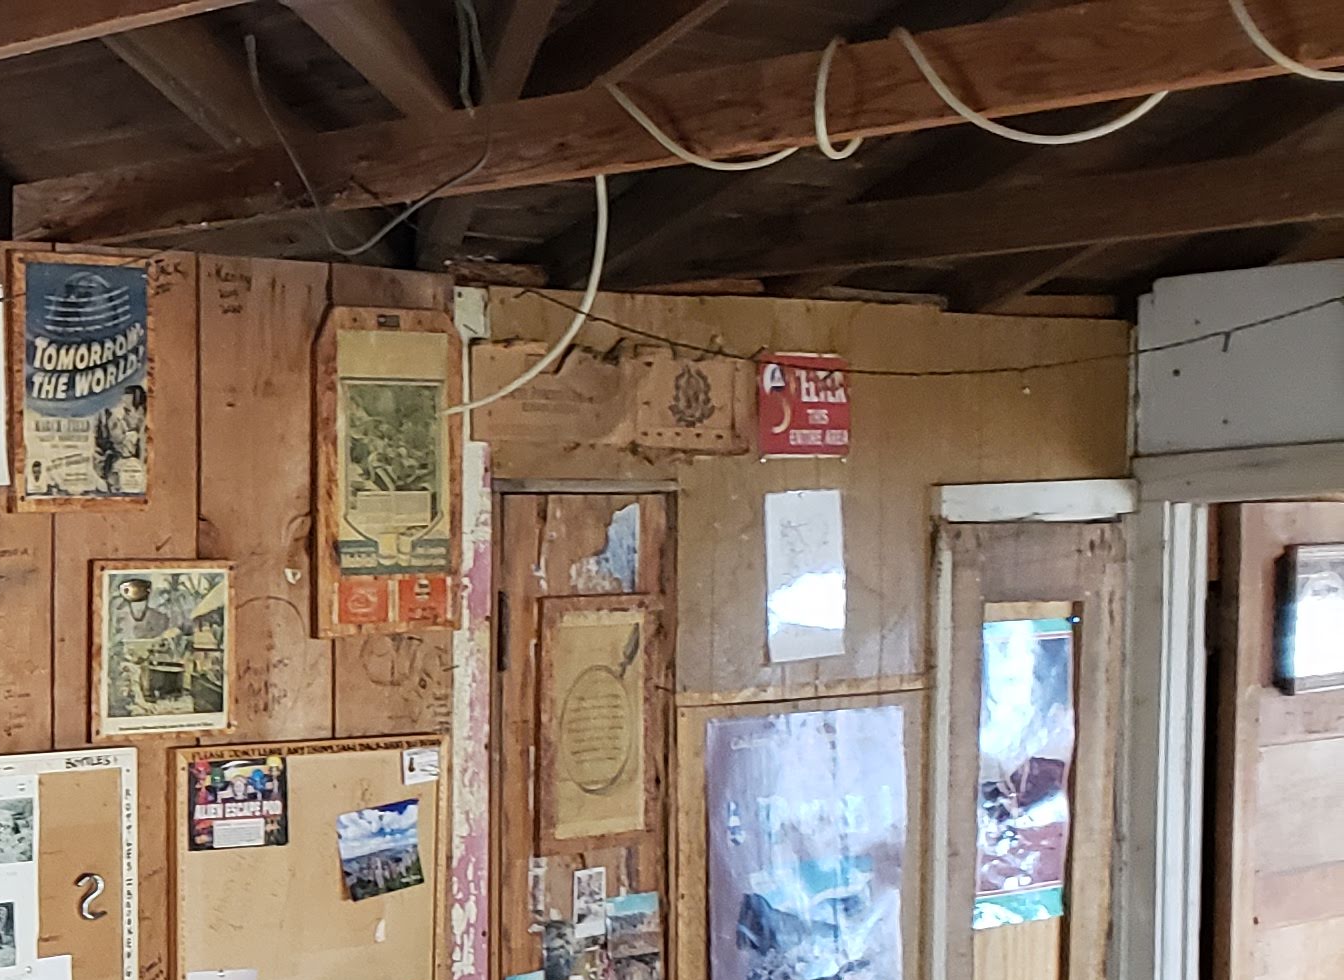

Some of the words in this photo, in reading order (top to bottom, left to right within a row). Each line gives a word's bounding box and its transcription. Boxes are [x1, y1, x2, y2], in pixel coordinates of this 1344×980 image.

[31, 372, 69, 400] THE
[75, 346, 144, 398] WORLD!
[789, 429, 823, 446] ENTIRE
[194, 803, 223, 819] ALIEN
[225, 801, 261, 817] ESCAPE
